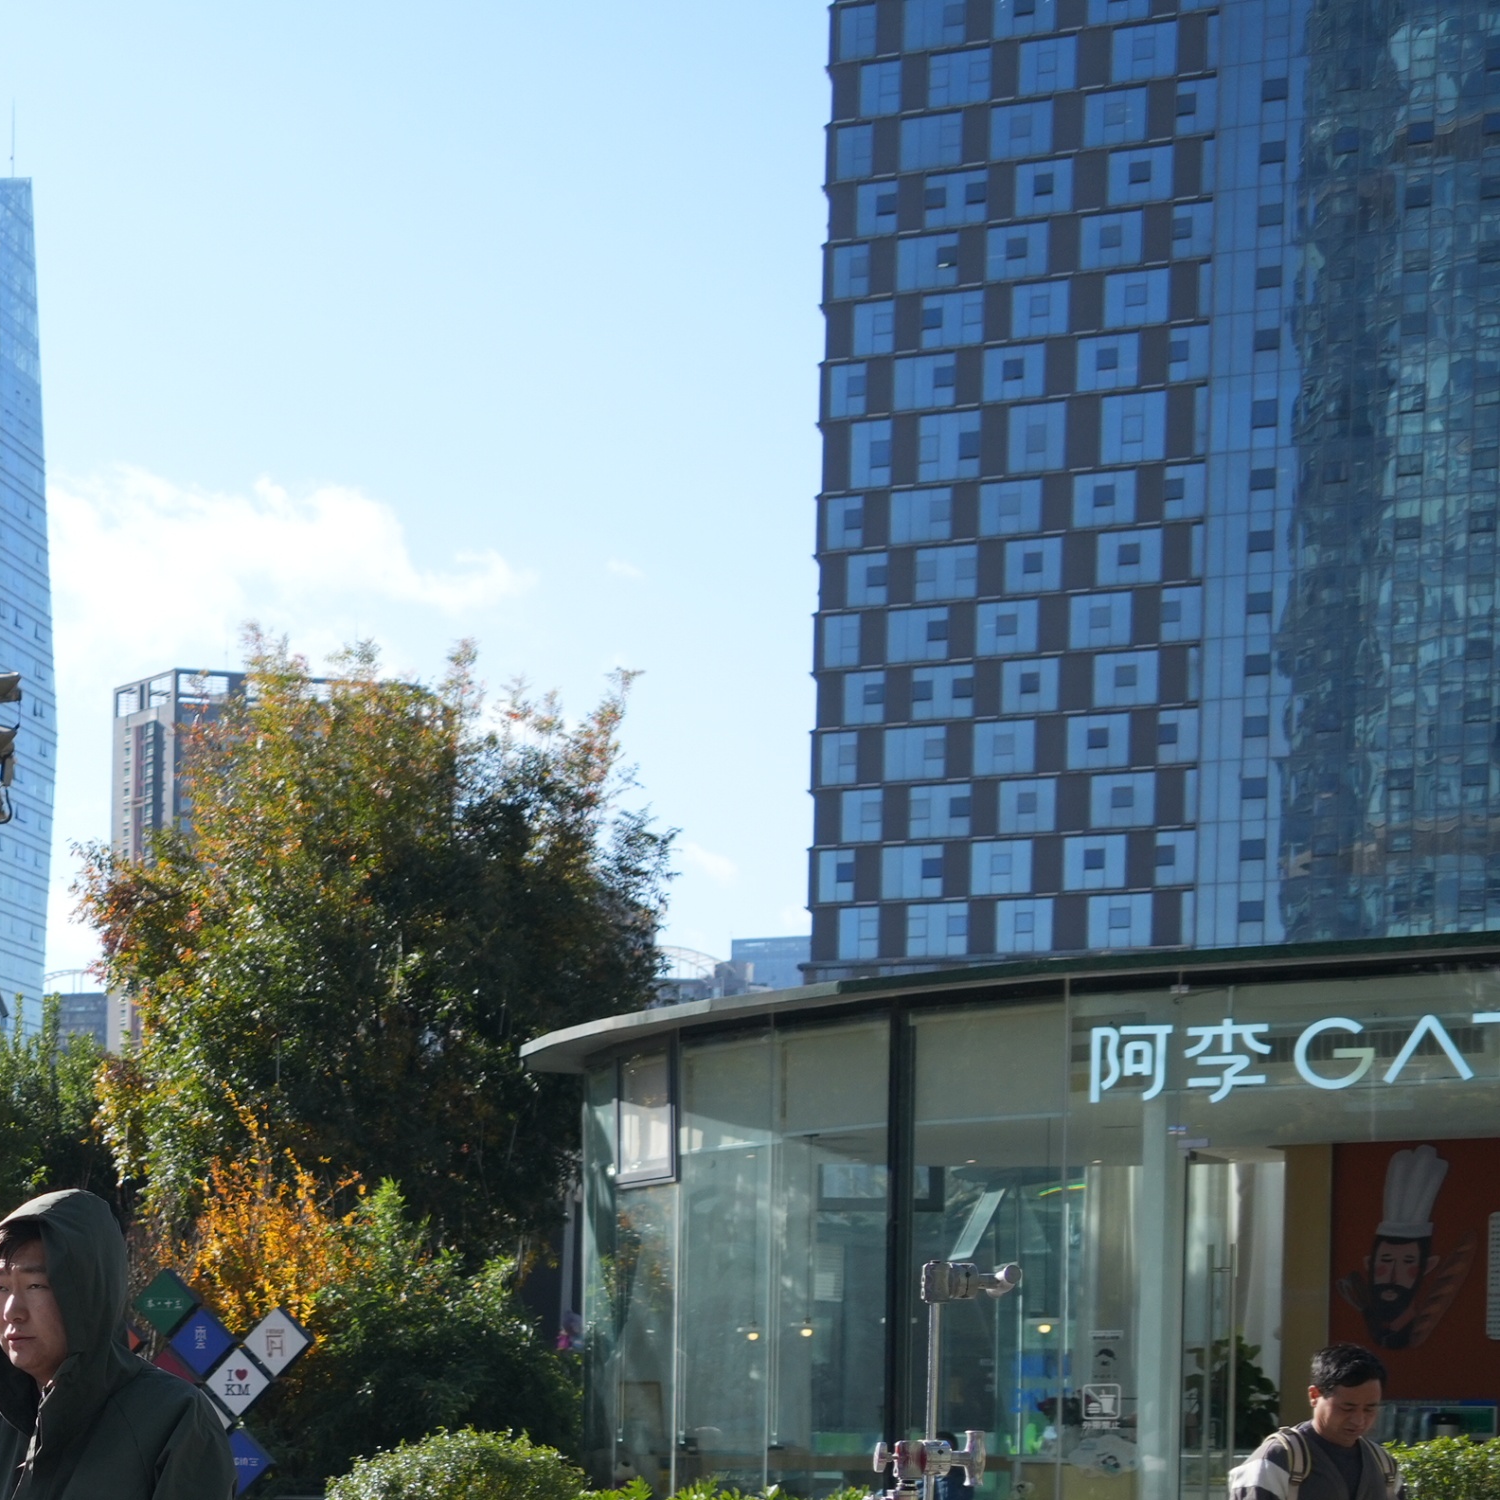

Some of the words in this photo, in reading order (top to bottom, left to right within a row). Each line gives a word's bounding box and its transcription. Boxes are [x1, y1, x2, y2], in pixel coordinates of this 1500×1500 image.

[1090, 1018, 1271, 1103] 阿李
[1294, 1013, 1500, 1090] GA
[225, 1384, 251, 1396] KM
